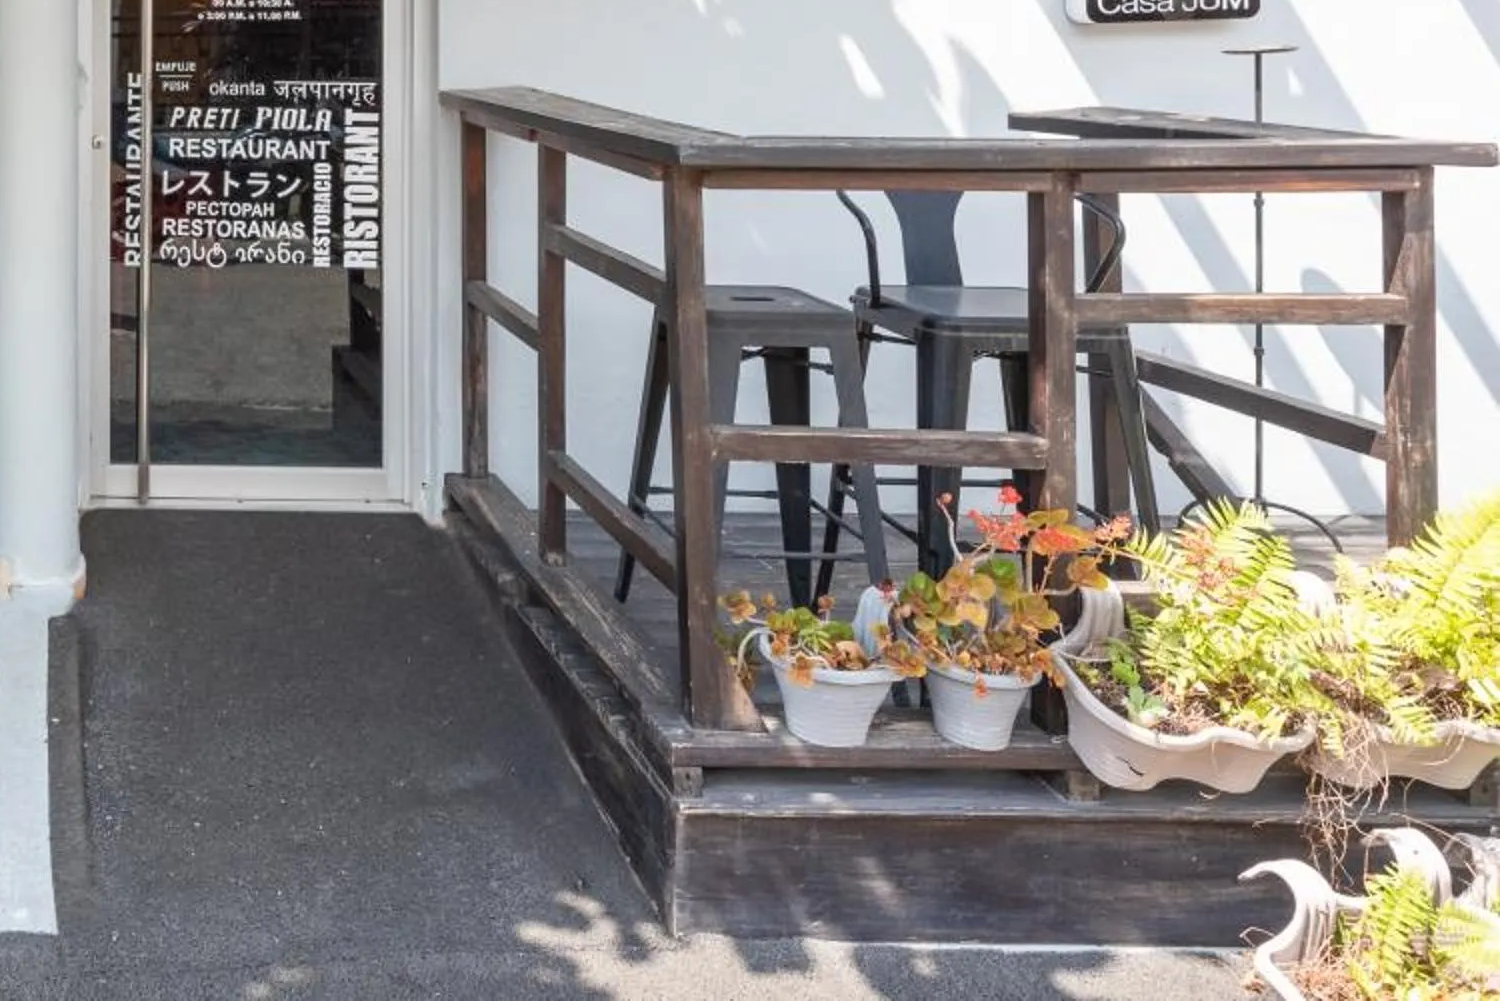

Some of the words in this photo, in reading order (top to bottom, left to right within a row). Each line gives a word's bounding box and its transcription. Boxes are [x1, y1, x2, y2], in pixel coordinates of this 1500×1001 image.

[155, 61, 197, 72] EMPUJE
[162, 80, 189, 92] PUSH
[209, 80, 265, 96] okanta
[170, 107, 240, 128] PRETI
[254, 107, 333, 132] PIOLA
[169, 138, 331, 160] RESTAURANT
[162, 170, 300, 198] レストラン
[343, 108, 380, 268] RISTORANT
[162, 218, 305, 239] RESTORANAS
